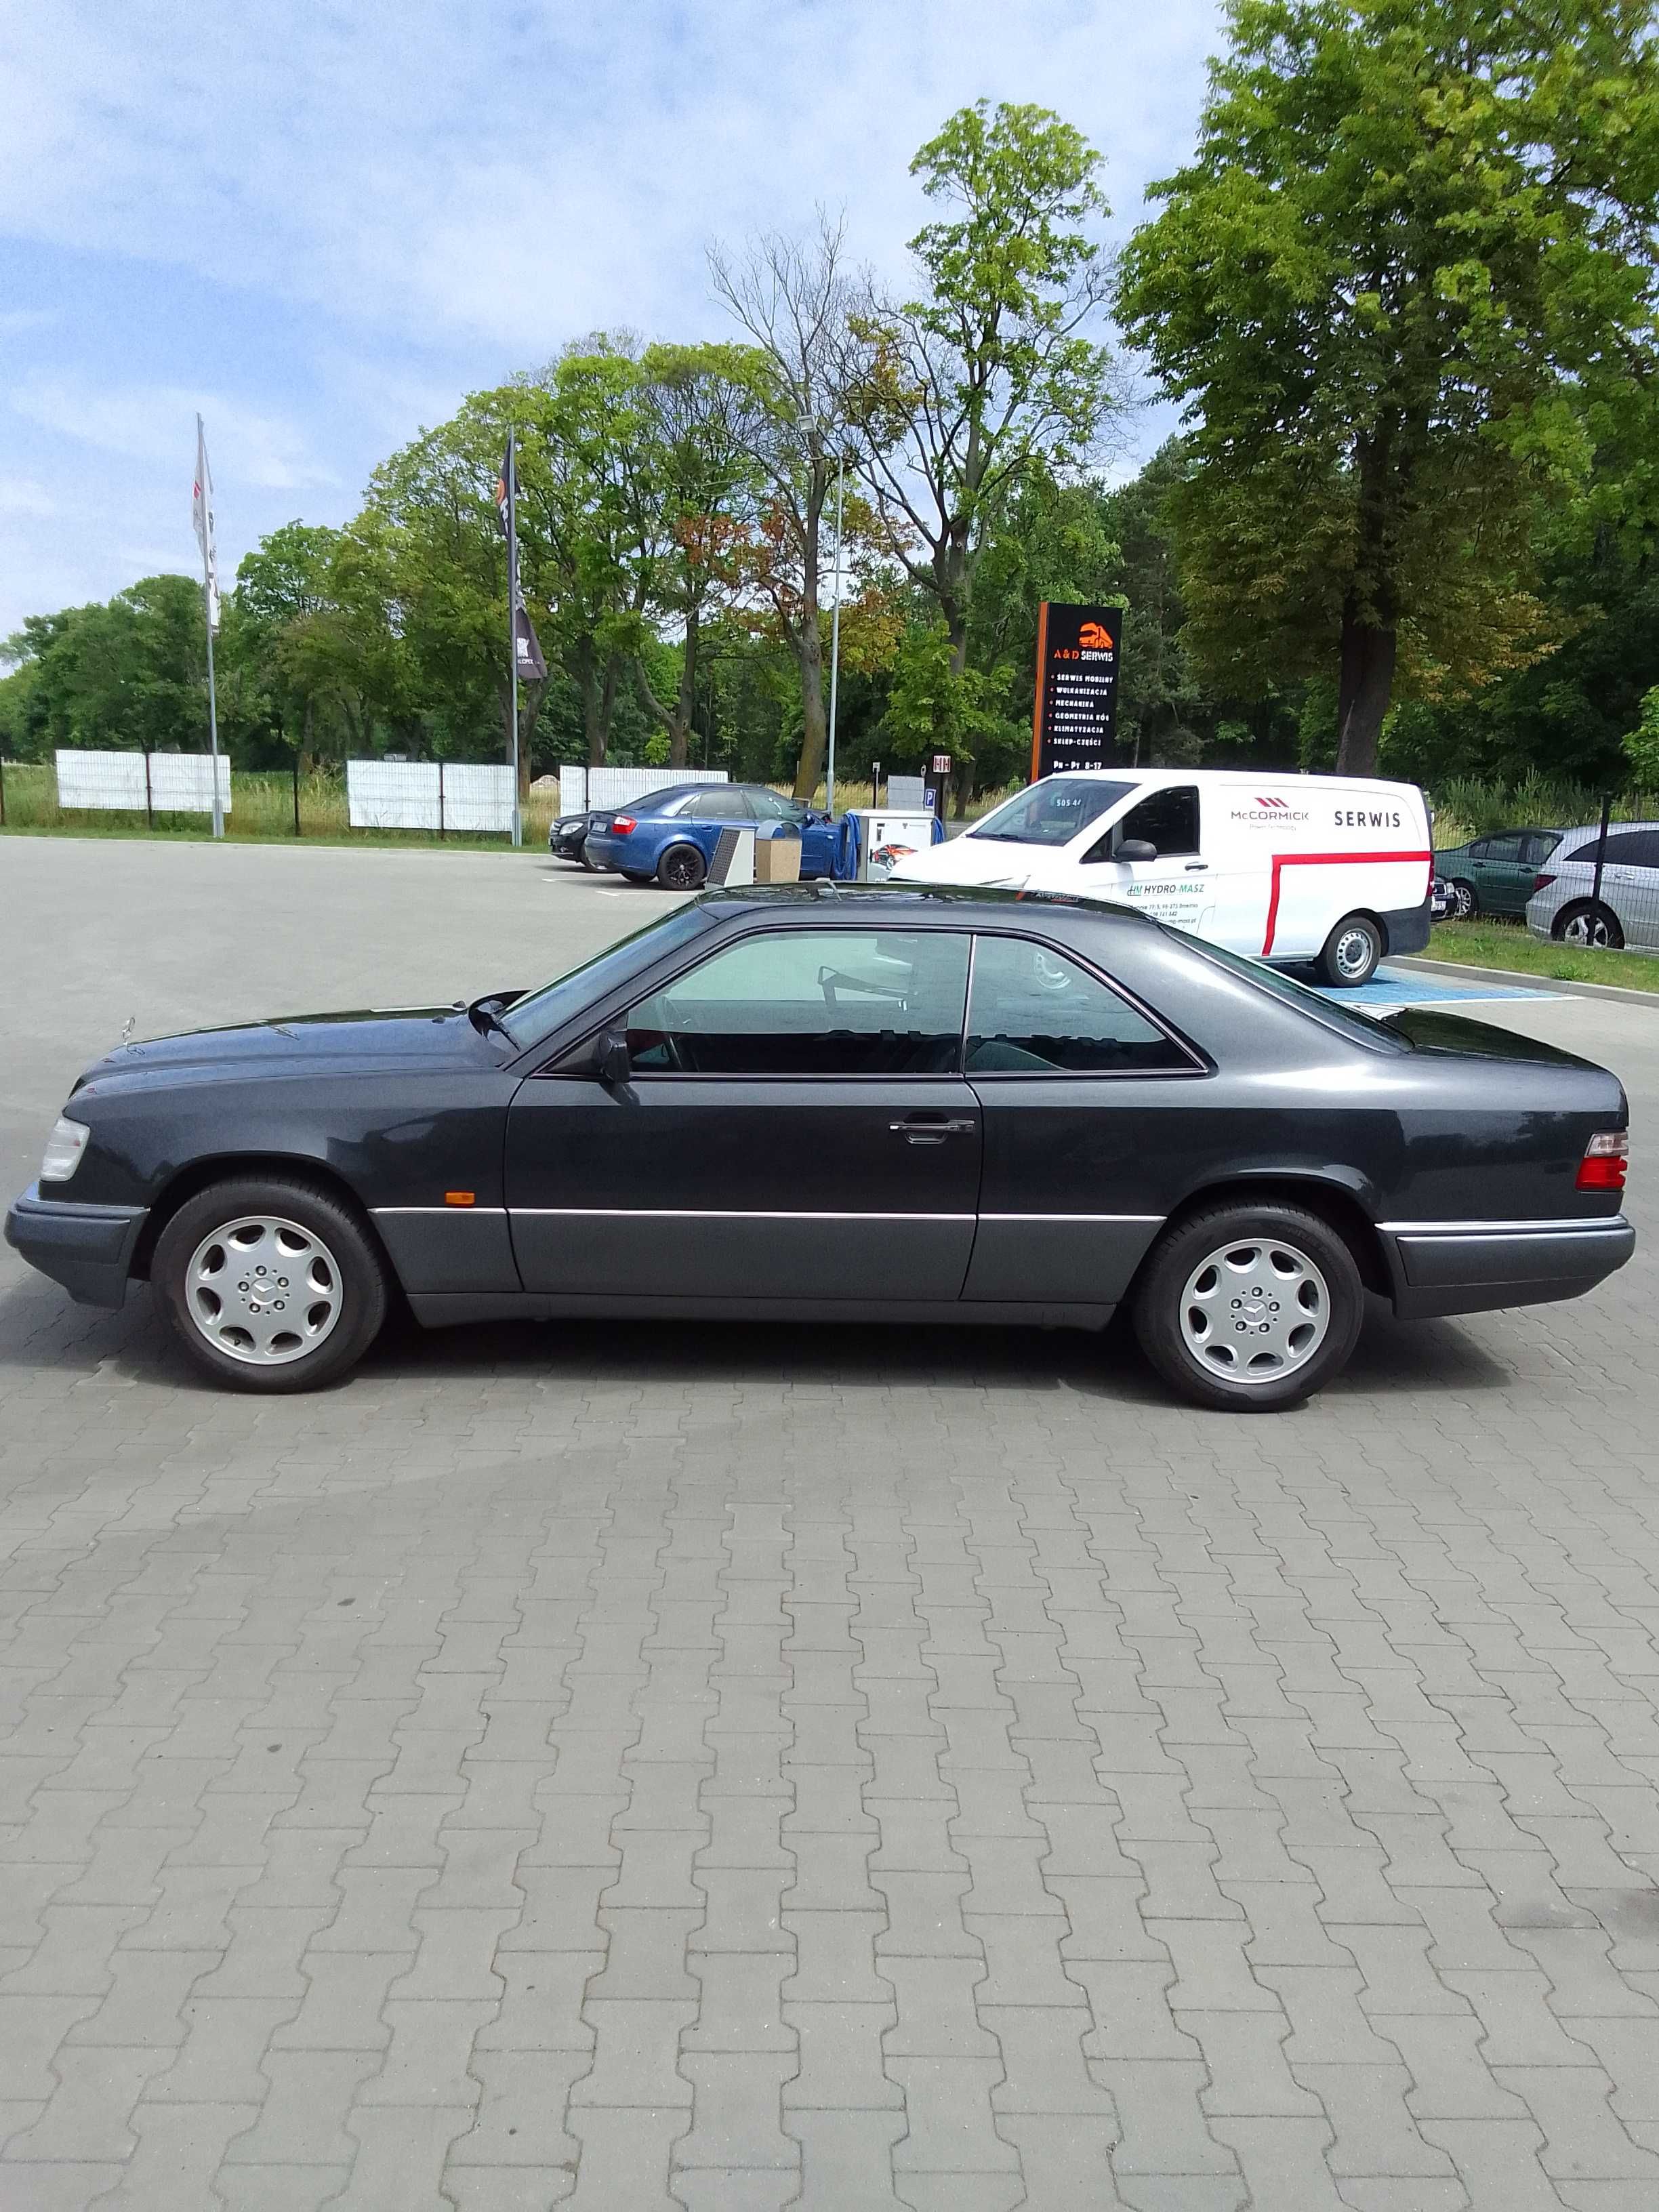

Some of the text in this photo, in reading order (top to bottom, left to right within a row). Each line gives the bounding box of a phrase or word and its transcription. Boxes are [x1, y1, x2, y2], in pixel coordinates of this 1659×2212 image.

[1081, 650, 1113, 662] SERWIS
[1057, 674, 1113, 684] SERWIS MOBILNY
[1056, 687, 1107, 696] WULKANIZACJA
[1055, 699, 1094, 708] MECHANIKA
[1055, 712, 1094, 720] GEOMETRIA
[1054, 725, 1104, 733] KLIMATYZACJA
[1084, 762, 1103, 770] 8-17
[926, 792, 933, 805] P
[1231, 811, 1309, 820] McCORMICK
[1334, 811, 1401, 827] SERWIS
[1143, 884, 1204, 894] HYDRO-MASZ
